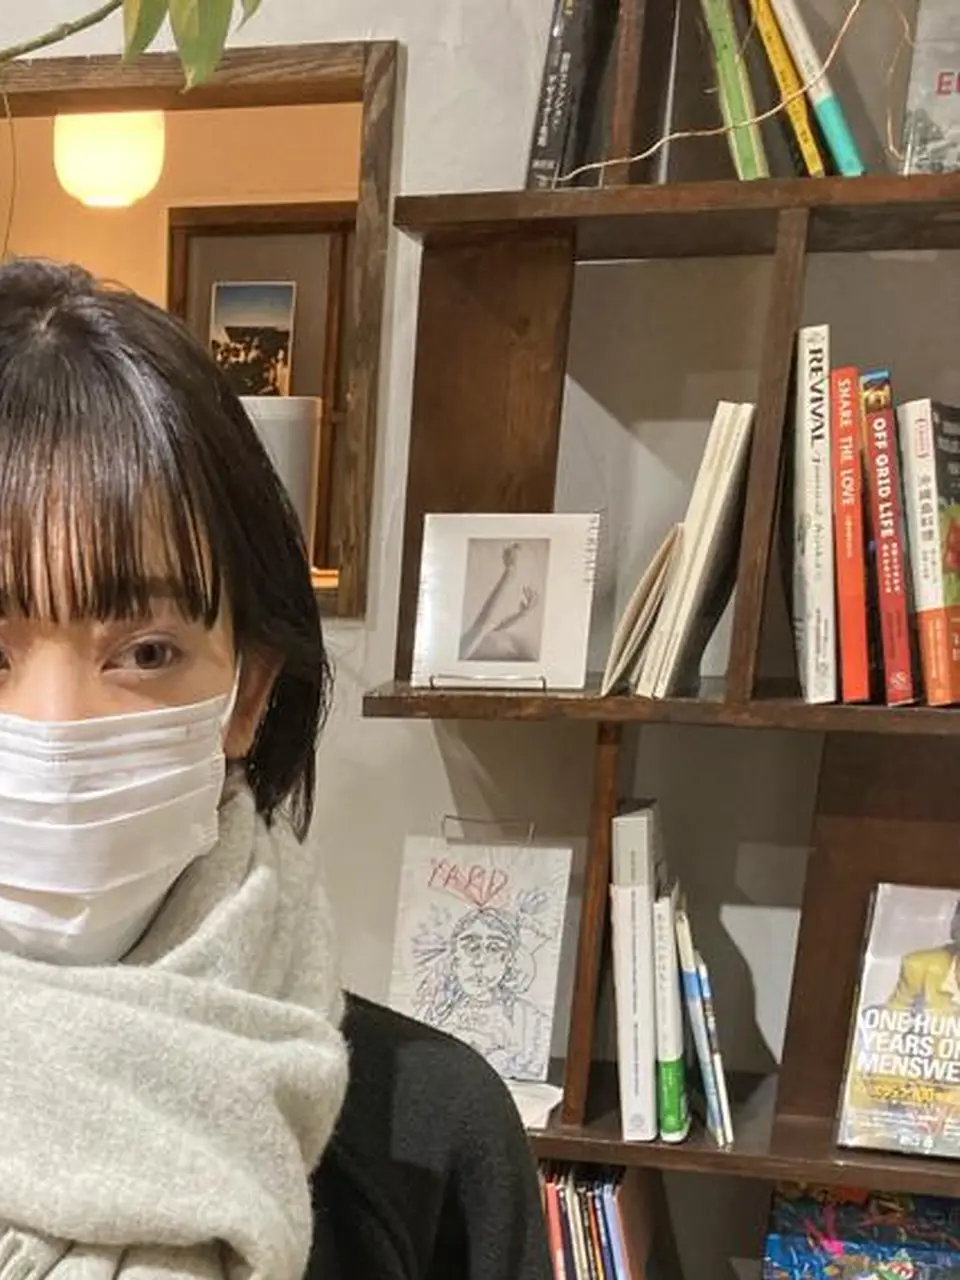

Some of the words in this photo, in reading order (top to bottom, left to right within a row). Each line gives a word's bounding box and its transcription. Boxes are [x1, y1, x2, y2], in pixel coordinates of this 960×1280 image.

[807, 347, 825, 448] REVIVAL
[838, 378, 853, 429] SHARE
[840, 436, 854, 461] THE
[872, 417, 888, 447] OFF
[840, 469, 856, 506] LOVE
[878, 501, 894, 538] LIFE
[865, 1008, 911, 1033] ONE
[860, 1030, 934, 1057] YEARS
